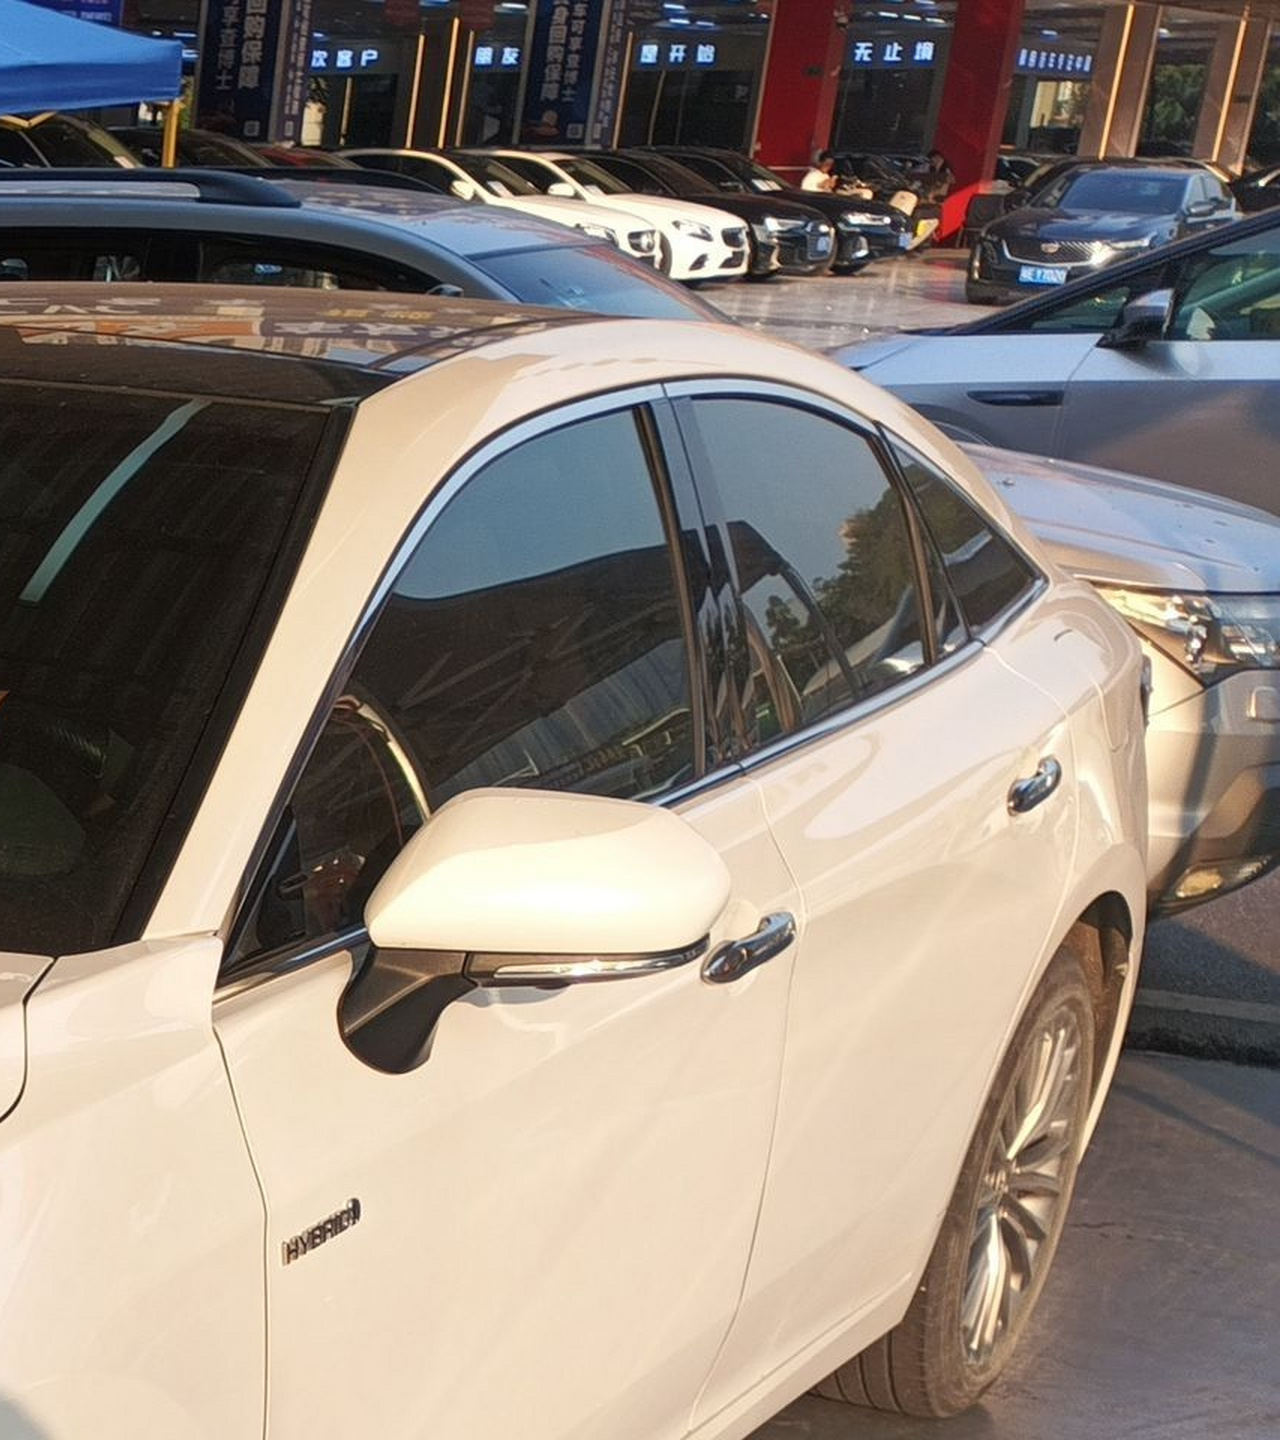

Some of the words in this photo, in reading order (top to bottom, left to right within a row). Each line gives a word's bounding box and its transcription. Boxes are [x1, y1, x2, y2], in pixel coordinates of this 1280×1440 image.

[539, 0, 571, 101] 身回购保障
[282, 1197, 361, 1267] HYBRID
